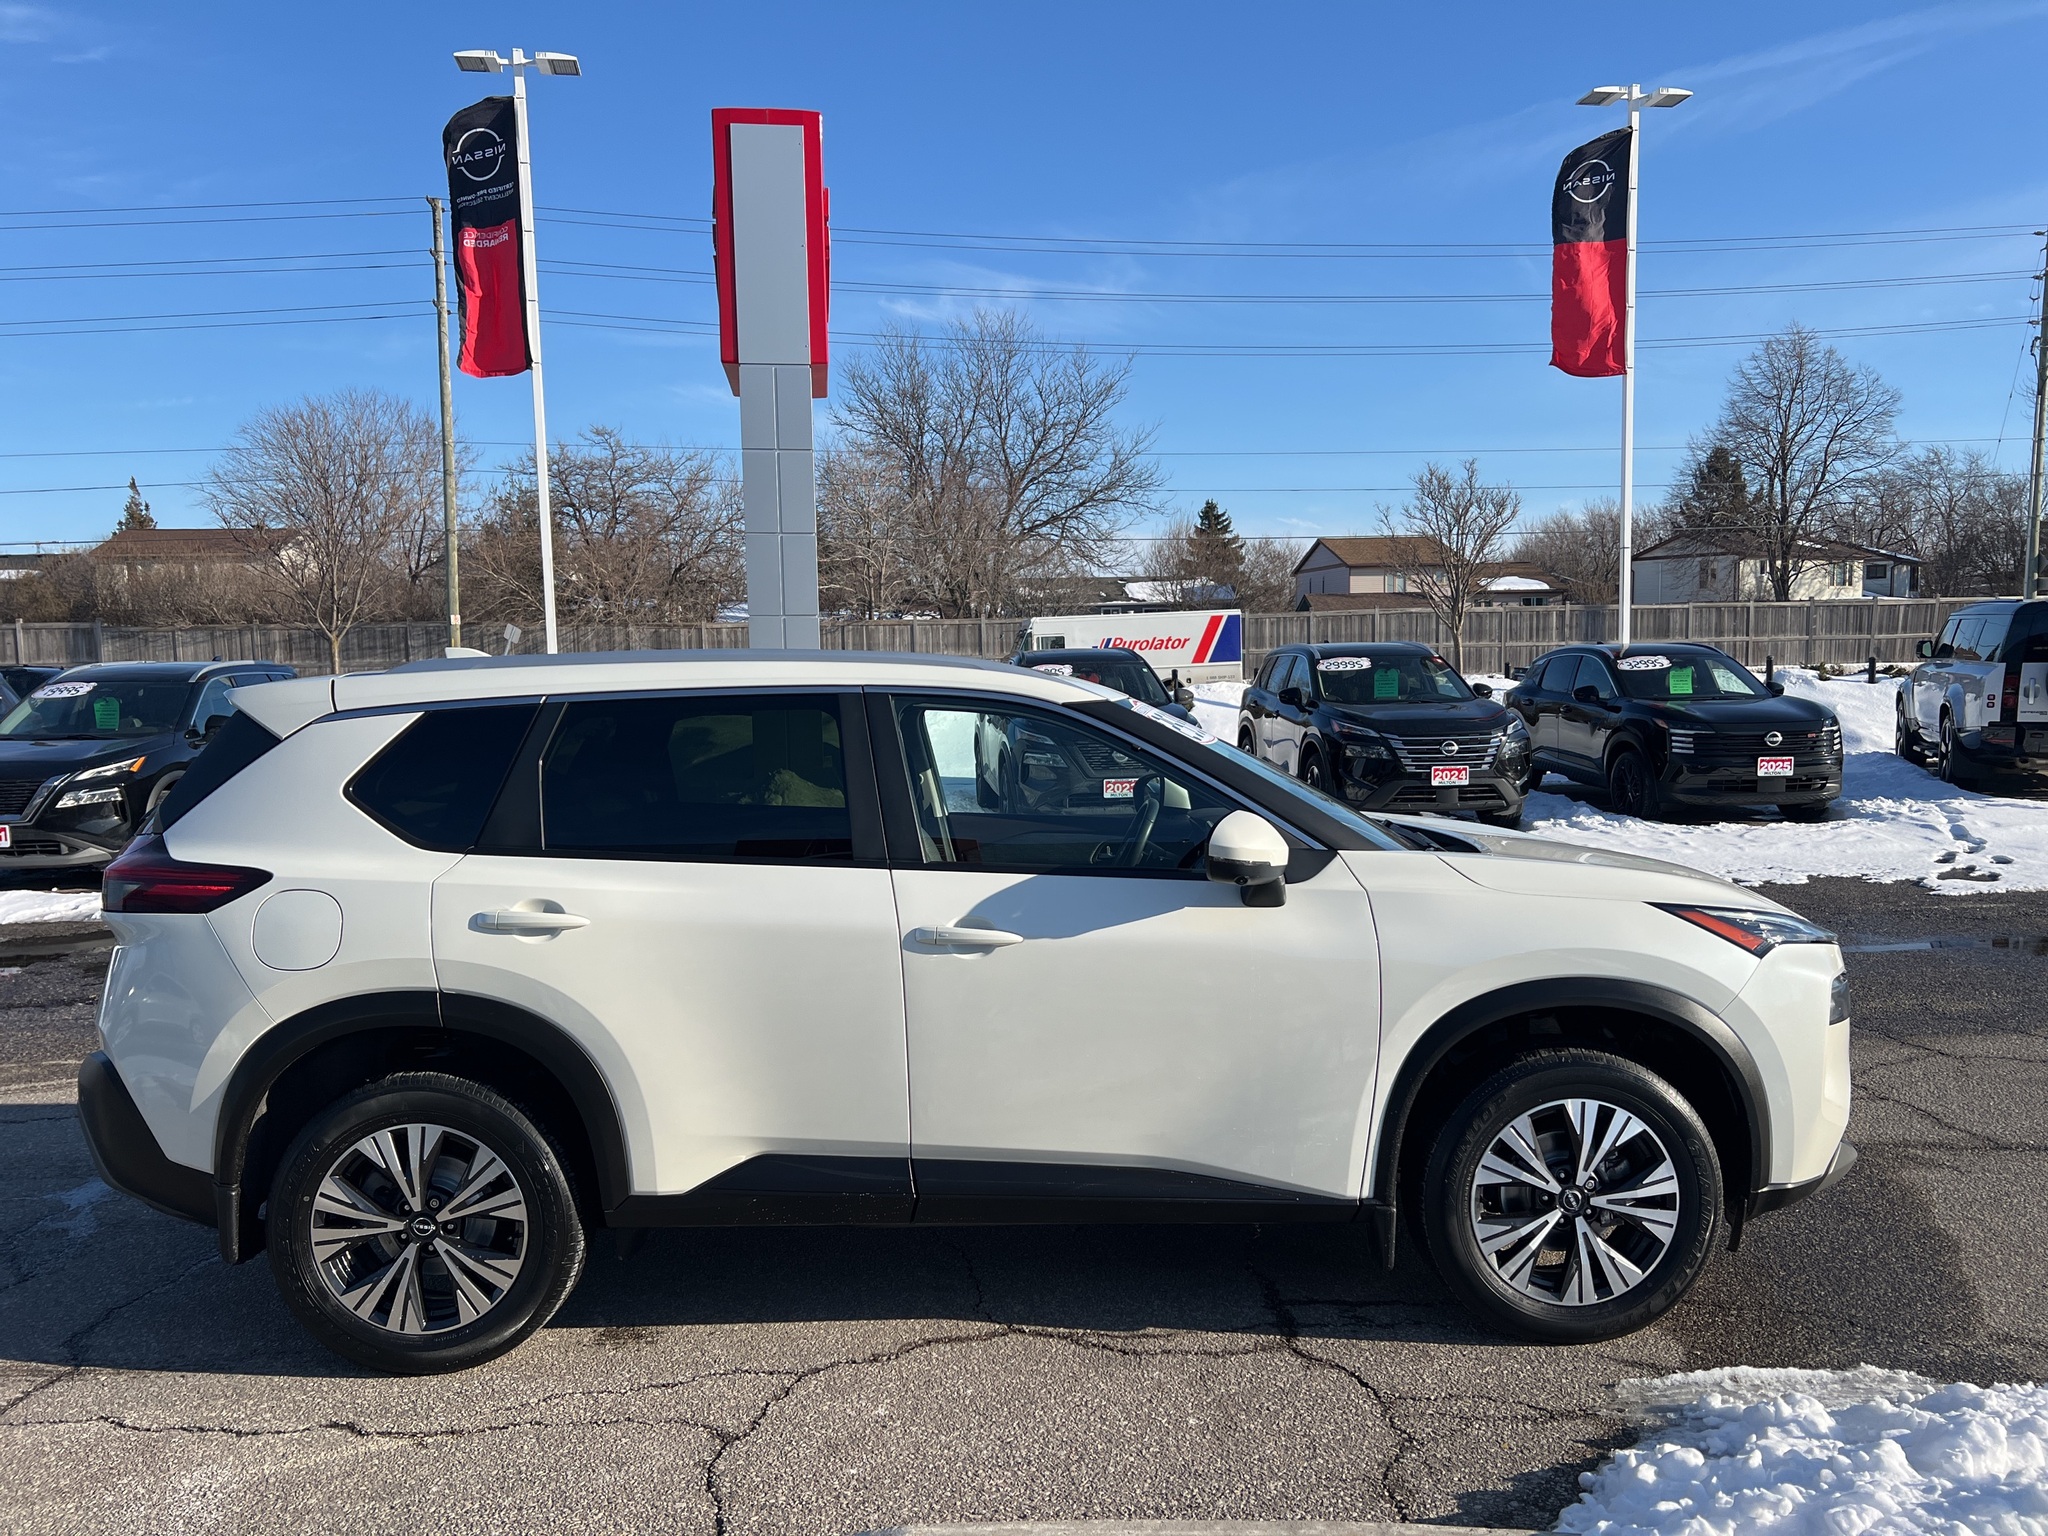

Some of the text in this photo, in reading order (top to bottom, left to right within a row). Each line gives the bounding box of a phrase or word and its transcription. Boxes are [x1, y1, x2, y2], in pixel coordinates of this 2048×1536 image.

[1112, 635, 1190, 651] Purolator
[1325, 660, 1364, 670] 29995
[1625, 659, 1664, 670] 32995
[43, 686, 84, 697] 19995
[1760, 761, 1791, 771] 2025
[1434, 770, 1467, 781] 2024
